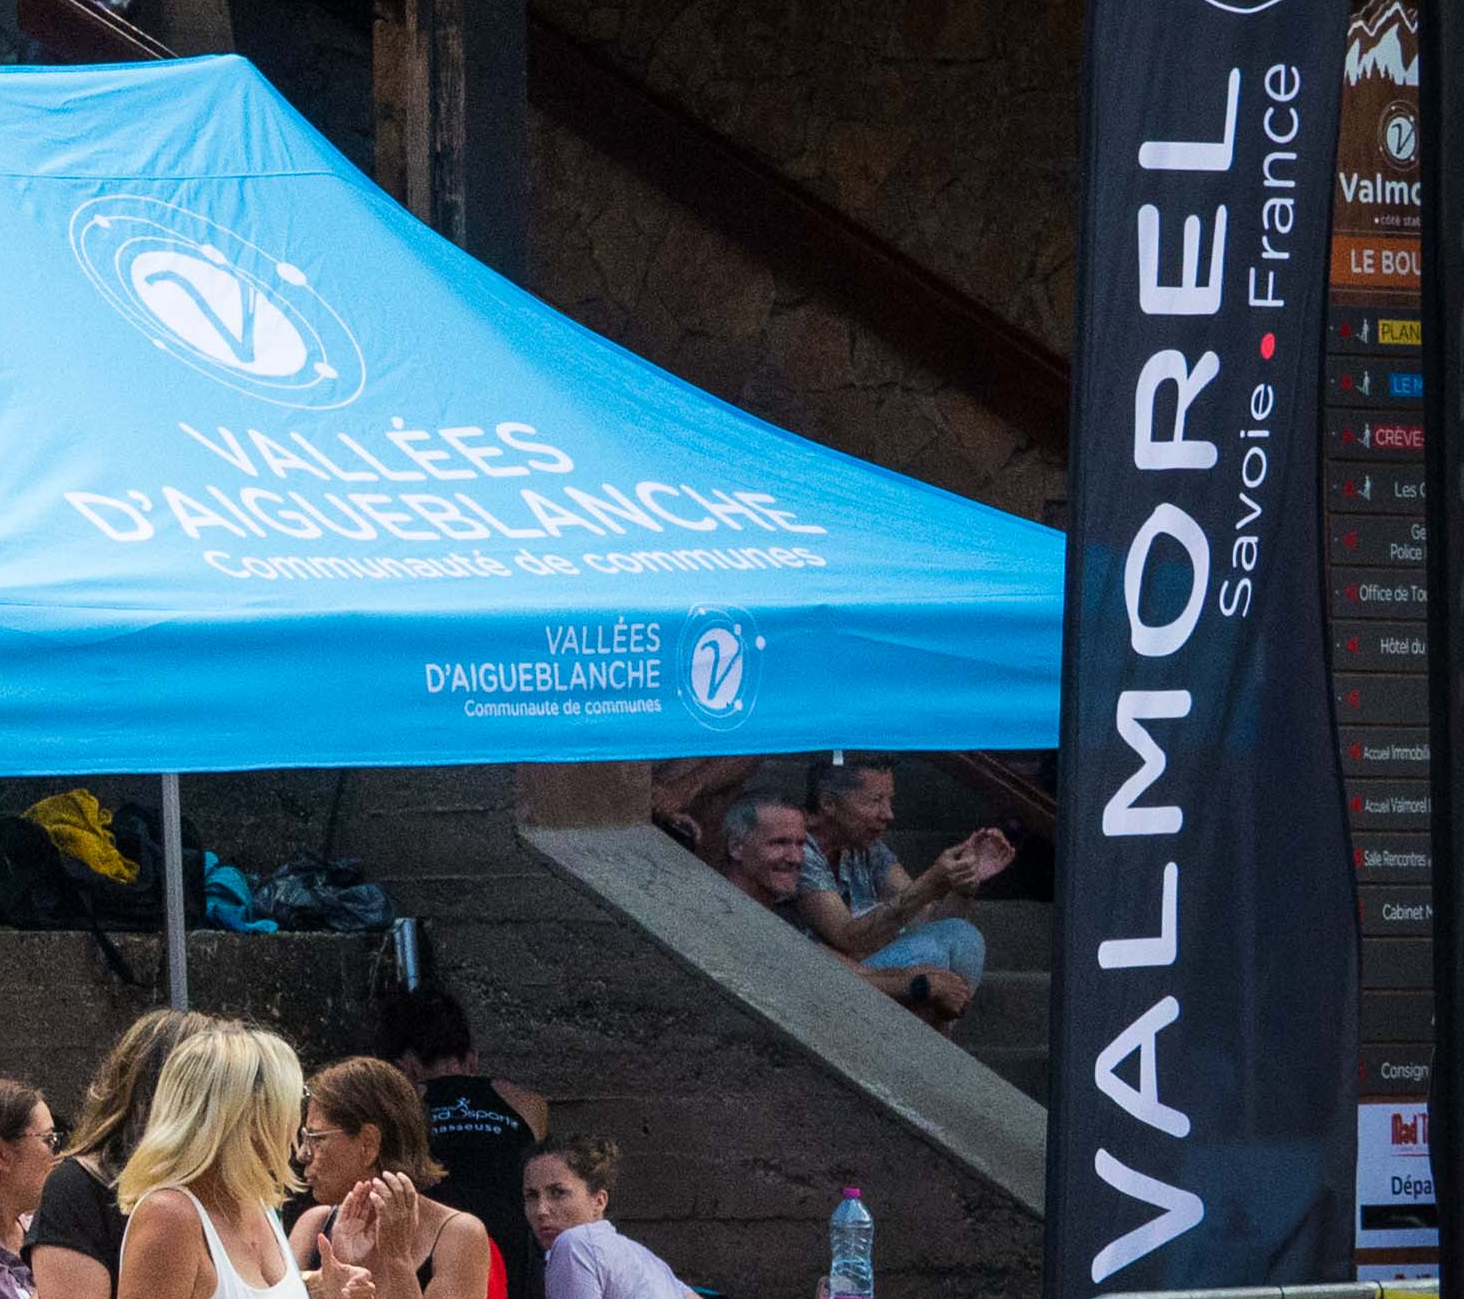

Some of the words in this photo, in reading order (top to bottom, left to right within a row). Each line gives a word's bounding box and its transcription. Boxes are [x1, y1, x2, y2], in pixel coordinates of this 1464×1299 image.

[1350, 249, 1375, 274] LE
[1221, 383, 1275, 617] Savoie
[1249, 63, 1301, 308] France
[178, 414, 575, 484] VALLÉES
[1394, 481, 1418, 498] Les
[64, 477, 830, 543] D'AIGUEBLANCHE
[204, 544, 507, 584] Communauté
[518, 545, 574, 577] de
[580, 542, 827, 574] communes
[1359, 584, 1394, 602] Office
[1395, 585, 1409, 601] de
[545, 615, 661, 655] VALLÉES
[1380, 638, 1406, 655] Hôtel
[425, 659, 661, 693] D'AIGUEBLANCHE
[1091, 67, 1241, 1284] VALMOREL
[563, 699, 582, 715] de
[585, 698, 662, 715] communes
[1382, 902, 1425, 921] Cabinet
[1381, 1061, 1429, 1081] Consign
[1392, 1175, 1432, 1199] Dépa
